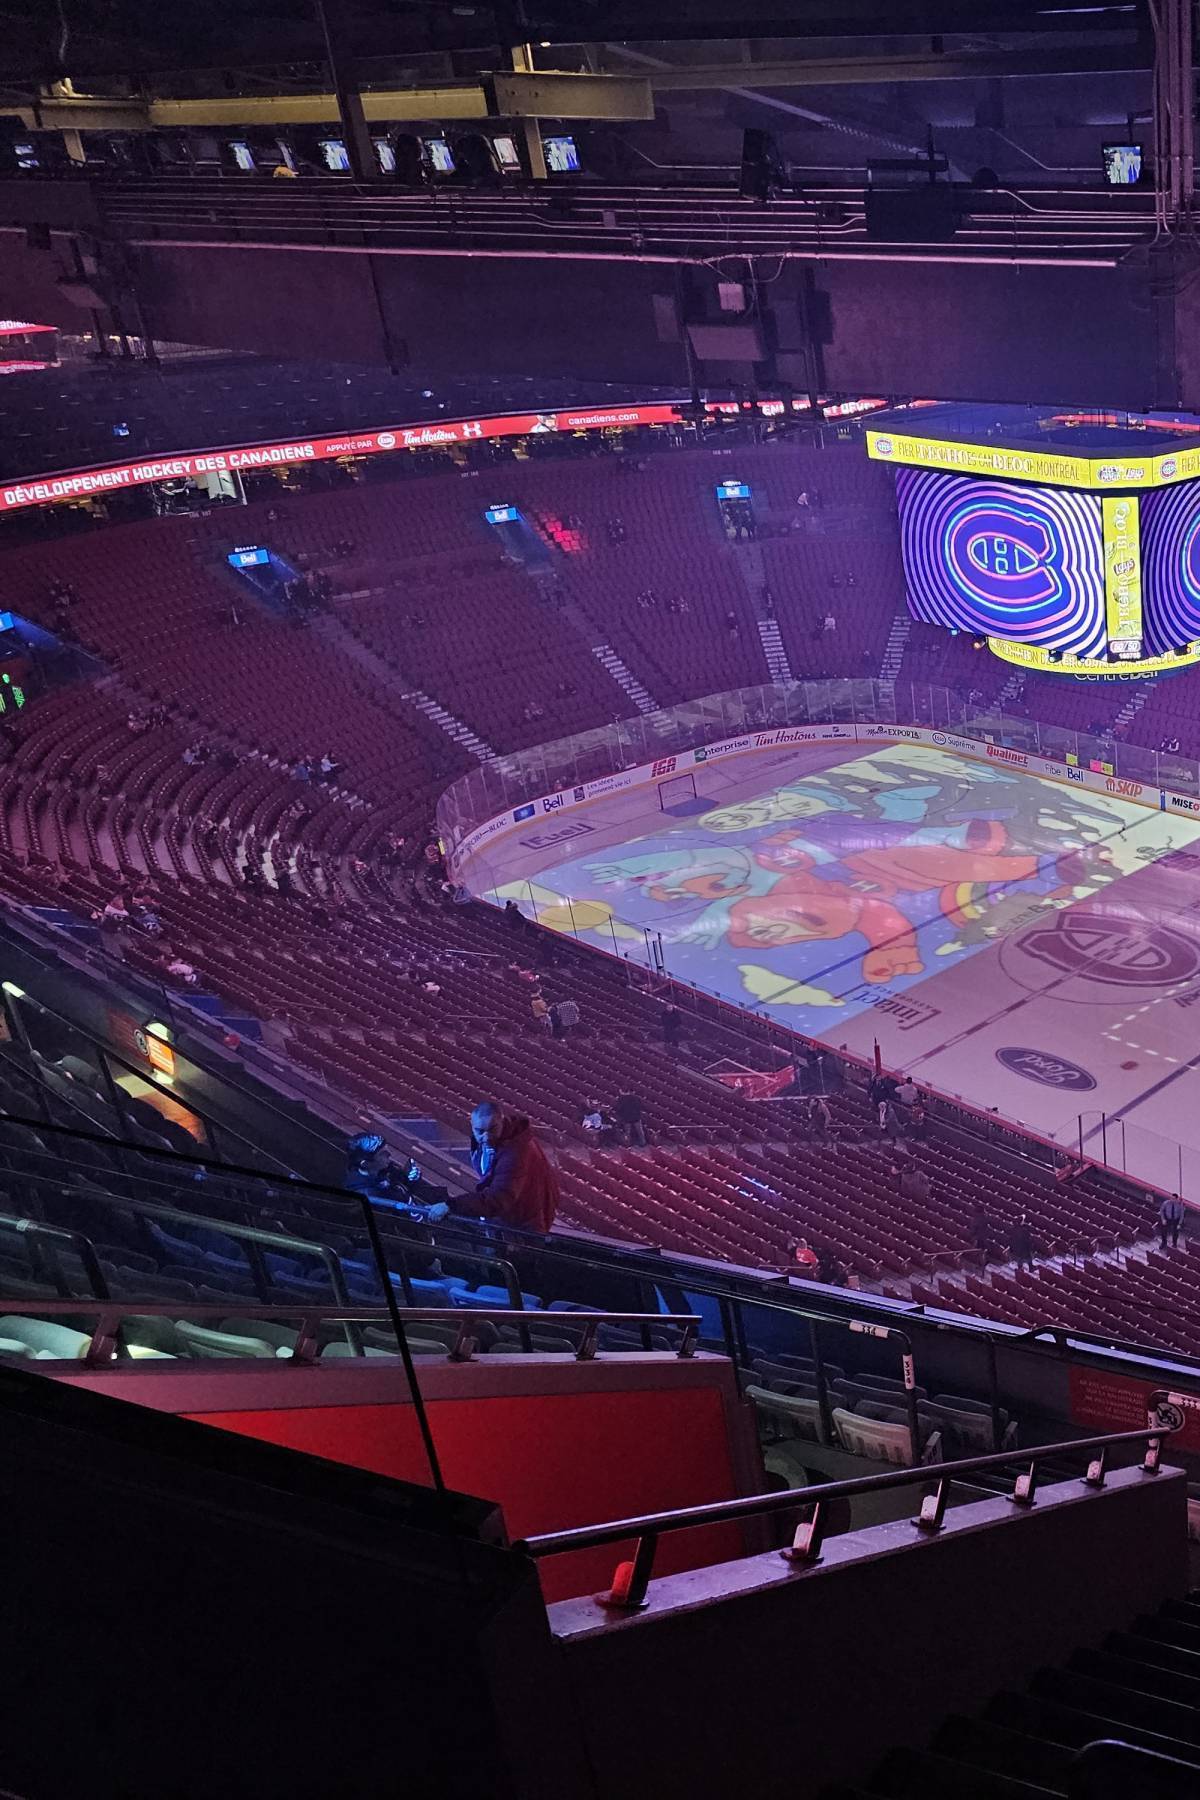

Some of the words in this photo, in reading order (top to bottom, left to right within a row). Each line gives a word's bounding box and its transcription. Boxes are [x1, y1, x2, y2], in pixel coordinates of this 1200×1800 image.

[568, 411, 640, 425] canadiens.com
[4, 470, 130, 506] DÉVELOPPEMENT
[132, 462, 191, 481] HOCKEY
[195, 456, 226, 472] DES
[229, 444, 315, 467] CANADIENS
[240, 554, 257, 565] Bell
[754, 734, 774, 747] Tim
[775, 731, 816, 744] Hortons
[948, 737, 976, 751] Suprême
[986, 744, 1028, 764] Qualinet
[1067, 767, 1084, 783] Bell
[1116, 783, 1143, 797] SKIP
[543, 795, 564, 812] Bell
[1013, 1053, 1080, 1084] Ford
